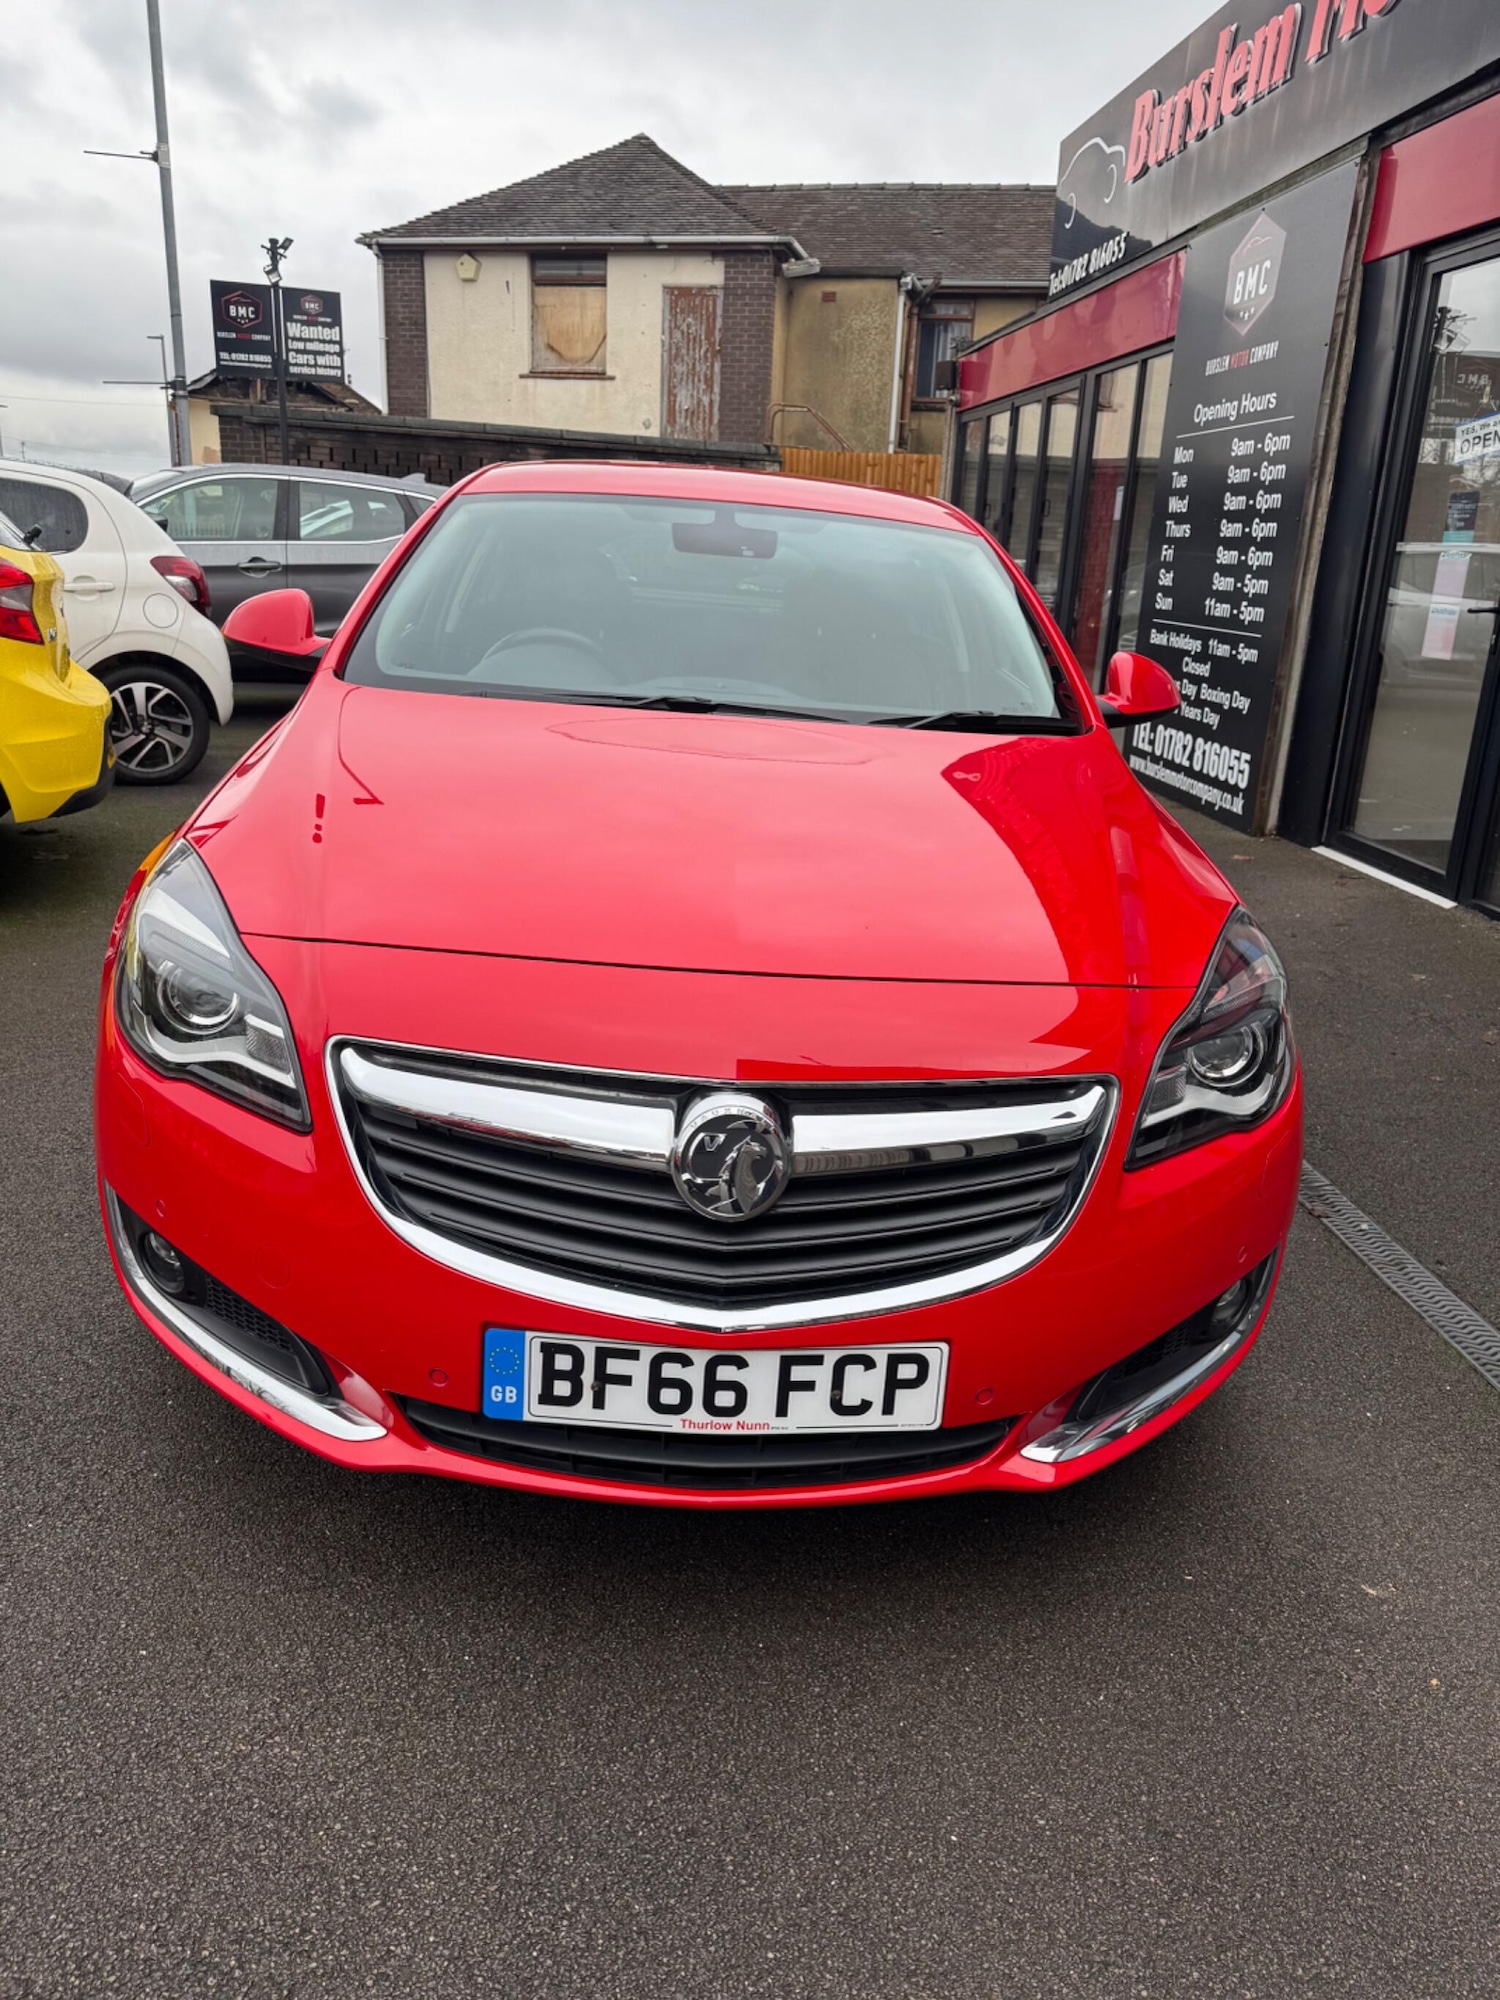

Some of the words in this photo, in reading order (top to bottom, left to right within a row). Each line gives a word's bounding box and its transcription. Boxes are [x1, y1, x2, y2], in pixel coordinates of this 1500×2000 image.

[1125, 2, 1302, 184] Burslem
[1233, 259, 1272, 305] BMC
[229, 305, 255, 318] BMC
[286, 322, 340, 341] Wanted
[288, 339, 305, 350] Low
[305, 341, 340, 353] mileage
[288, 351, 315, 365] Cars
[316, 354, 341, 367] with
[1249, 340, 1279, 364] COMPANY
[289, 366, 315, 375] service
[1193, 398, 1239, 427] Opening
[1240, 391, 1277, 415] Hours
[1461, 426, 1478, 436] YES,
[1173, 446, 1194, 464] Mon
[1230, 437, 1255, 457] 9am
[1264, 432, 1291, 457] 6pm
[1171, 471, 1188, 489] Tue
[1227, 464, 1251, 484] 9am
[1260, 461, 1286, 486] 6pm
[1168, 495, 1189, 514] Wed
[1223, 491, 1247, 511] 9am
[1255, 489, 1282, 514] 6pm
[1165, 520, 1191, 538] Thurs
[1219, 518, 1243, 537] 9am
[1251, 517, 1278, 542] 6pm
[1161, 545, 1175, 562] Fri
[1216, 545, 1239, 565] 9am
[1247, 546, 1273, 571] 6pm
[1158, 568, 1174, 586] Sat
[1212, 571, 1235, 591] 9am
[1243, 573, 1269, 598] 5pm
[1155, 592, 1173, 610] Sun
[1204, 597, 1231, 618] 11am
[1239, 601, 1265, 625] 5pm
[1149, 628, 1168, 646] Bank
[1168, 631, 1202, 655] Holidays
[1208, 638, 1231, 658] 11am
[1237, 643, 1259, 665] 5pm
[1182, 656, 1211, 677] Closed
[1181, 679, 1198, 700] Day
[1200, 683, 1231, 710] Boxing
[1231, 690, 1251, 714] Day
[1180, 701, 1202, 721] Years
[1202, 707, 1221, 730] Day
[1154, 724, 1193, 767] 01782
[1193, 737, 1252, 789] 816055
[537, 1341, 750, 1418] BF66
[775, 1352, 930, 1418] FCP
[490, 1385, 518, 1403] GB
[680, 1418, 732, 1431] Thurlow
[736, 1420, 770, 1431] Nunn
